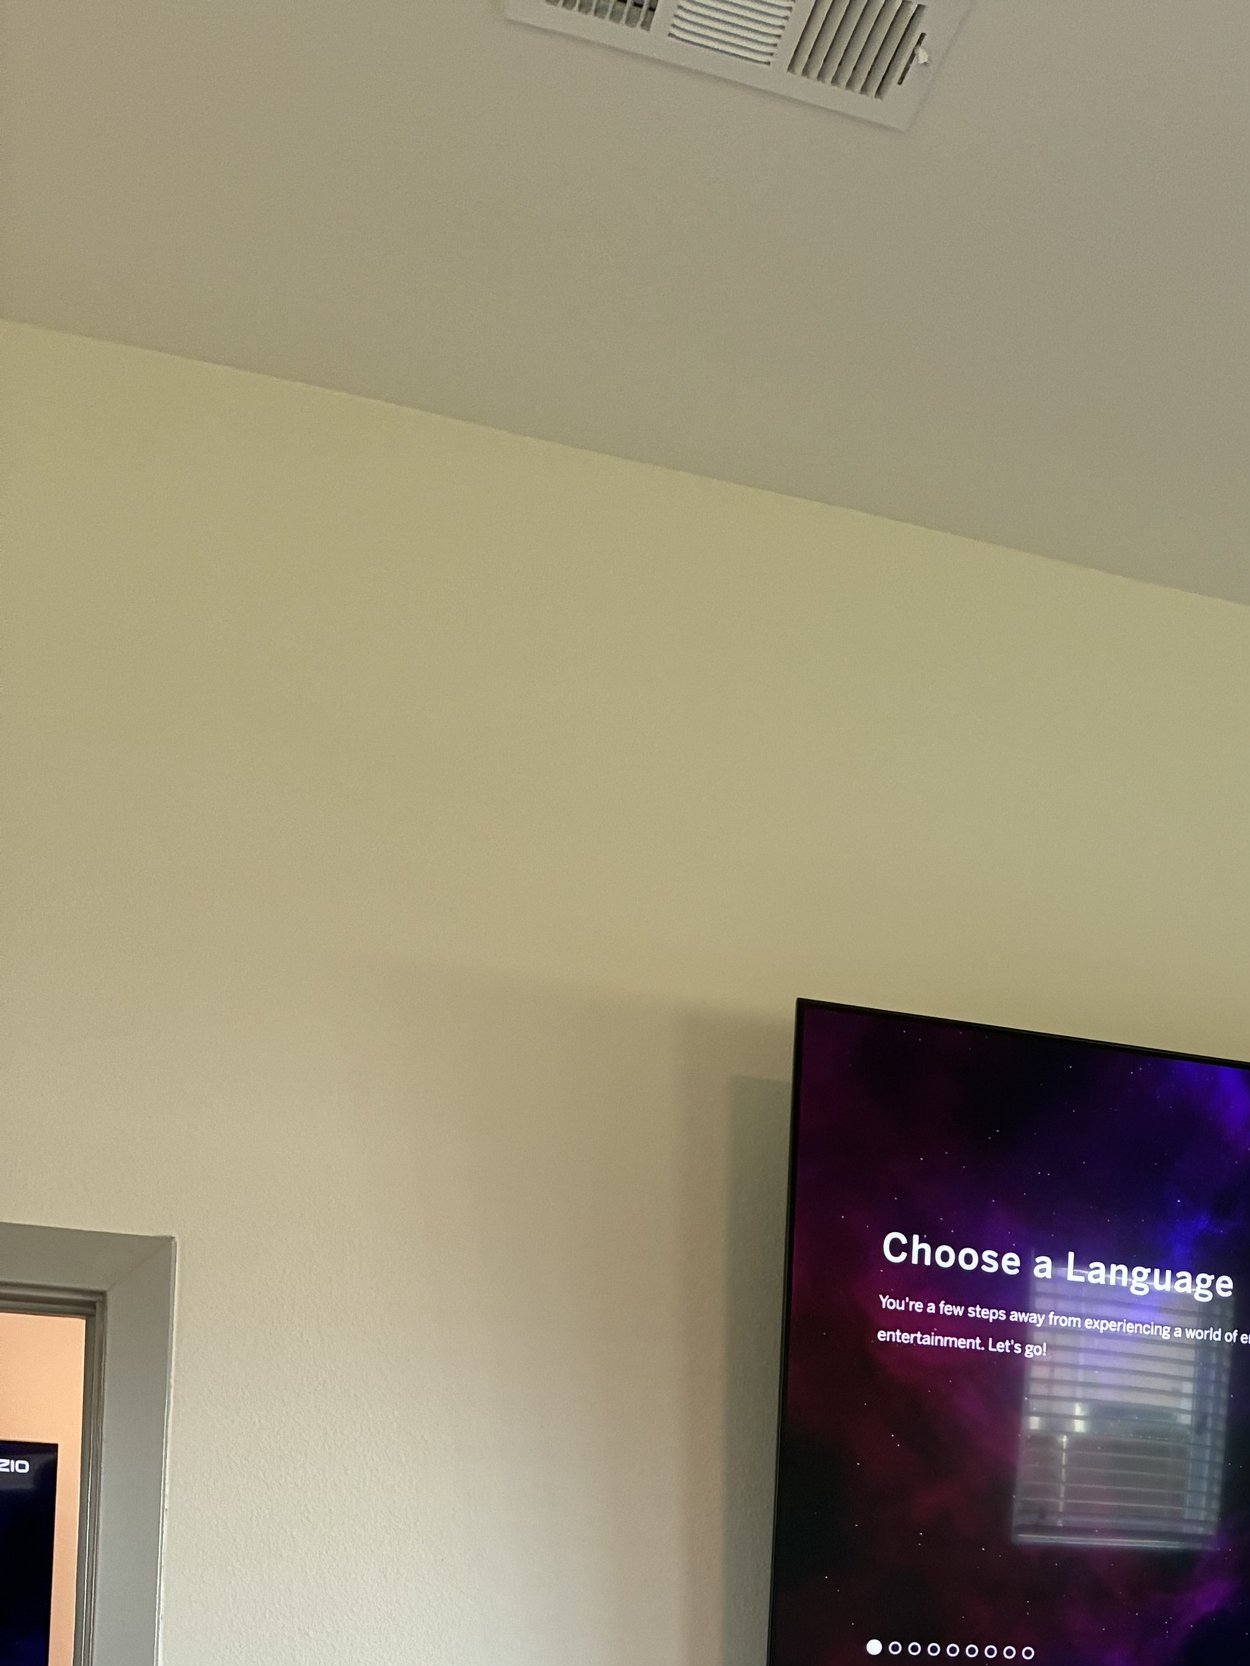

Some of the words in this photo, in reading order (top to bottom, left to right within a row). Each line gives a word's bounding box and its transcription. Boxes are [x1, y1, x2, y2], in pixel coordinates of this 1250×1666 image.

[882, 1231, 1021, 1275] Choose
[1033, 1254, 1053, 1279] a
[1066, 1251, 1234, 1302] Language
[876, 1328, 985, 1351] entertainment.
[988, 1337, 1022, 1354] Let's
[1024, 1342, 1048, 1358] go!
[879, 1294, 924, 1313] You're
[926, 1302, 936, 1314] a
[939, 1300, 965, 1317] few
[967, 1305, 1007, 1323] steps
[1009, 1311, 1046, 1328] away
[1048, 1311, 1082, 1328] from
[1084, 1317, 1172, 1340] experiencing
[1173, 1325, 1183, 1338] a
[1184, 1326, 1222, 1342] world
[1224, 1329, 1238, 1344] of
